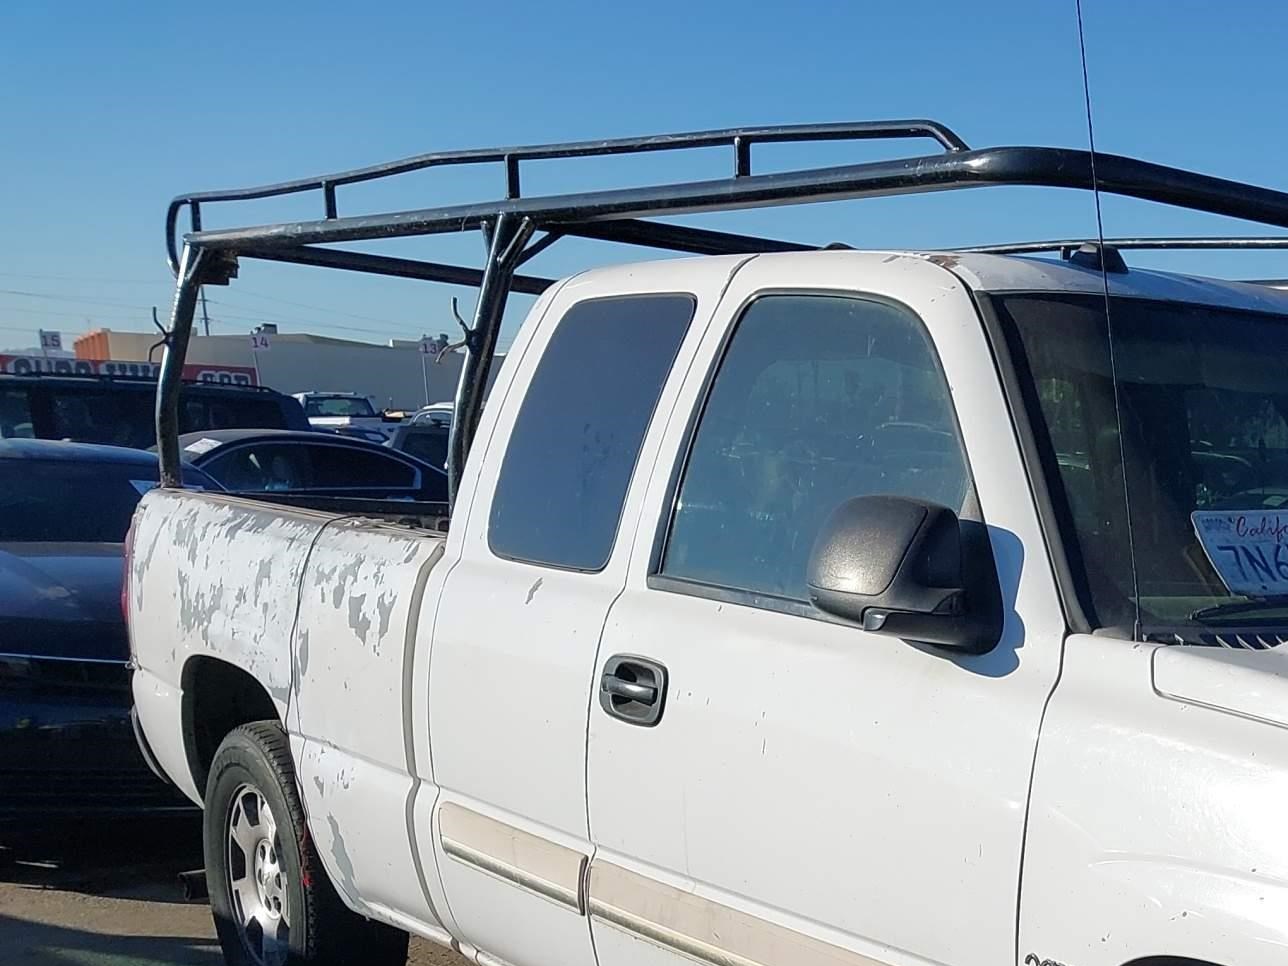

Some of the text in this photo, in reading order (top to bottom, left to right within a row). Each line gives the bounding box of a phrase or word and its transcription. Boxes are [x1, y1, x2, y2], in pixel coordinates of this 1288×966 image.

[42, 334, 61, 347] 15
[252, 336, 269, 348] 14
[422, 342, 437, 354] 13
